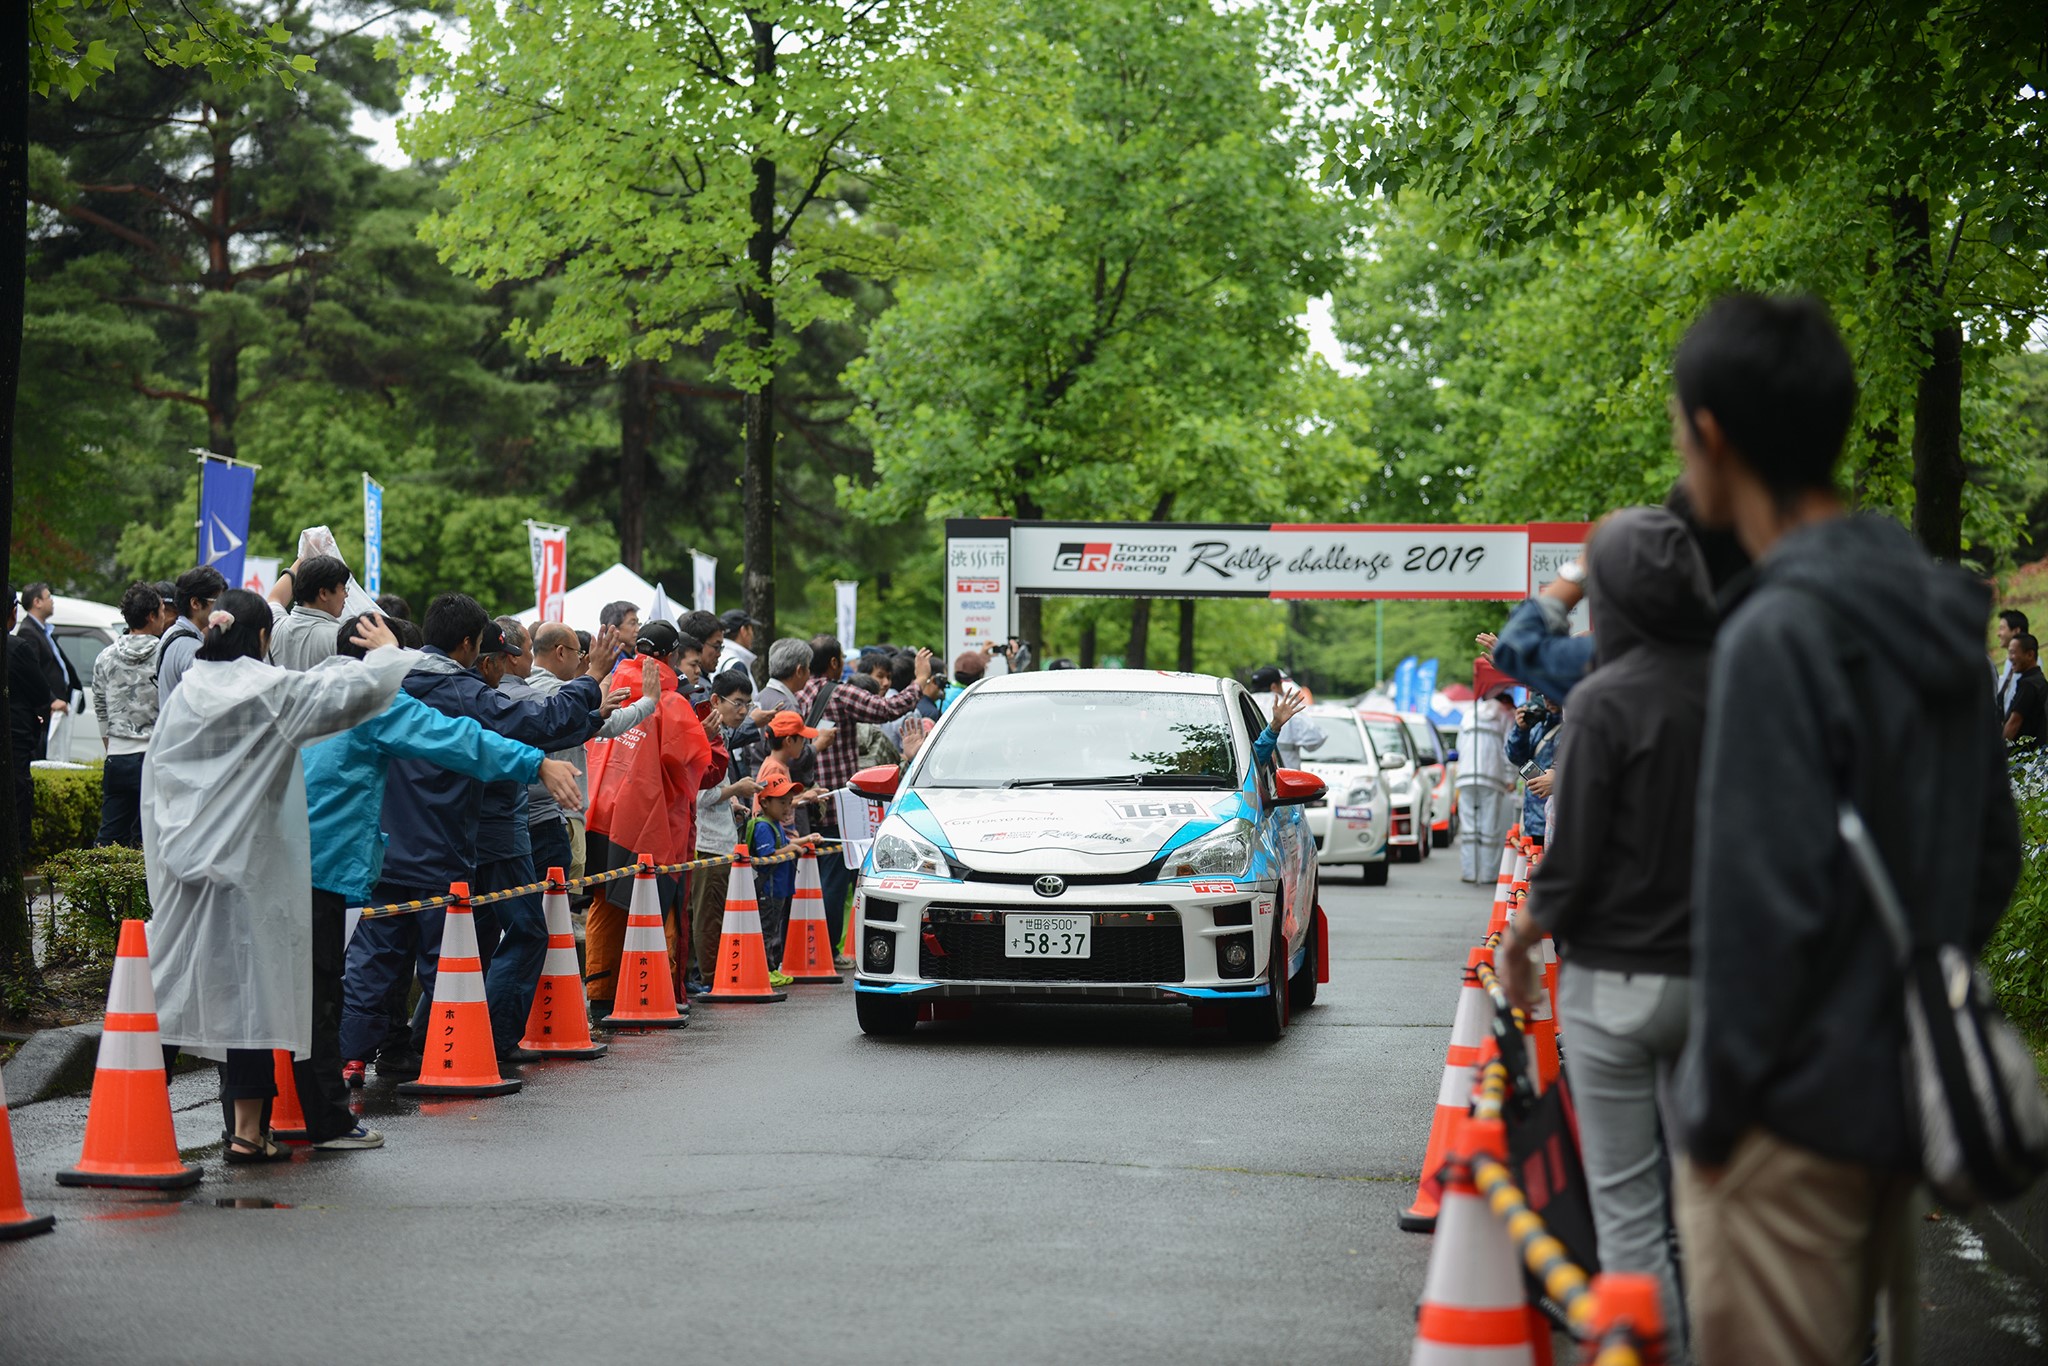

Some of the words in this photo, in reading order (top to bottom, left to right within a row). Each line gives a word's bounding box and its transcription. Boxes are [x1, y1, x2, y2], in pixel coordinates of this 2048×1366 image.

[1115, 543, 1178, 553] TOYOTA
[951, 549, 1006, 568] 渋川市
[1113, 553, 1171, 563] GAZOO
[1183, 541, 1281, 581] Rally
[1288, 545, 1392, 580] challenge
[1403, 546, 1486, 573] 2019
[1111, 563, 1167, 574] Racing
[957, 580, 1000, 593] TRD
[621, 732, 640, 742] ZOO
[629, 728, 647, 738] OTA
[1119, 803, 1197, 817] 168
[1038, 829, 1082, 840] Rally
[1084, 832, 1133, 844] challenge
[881, 879, 918, 889] TRD
[1193, 884, 1236, 893] TRD
[1024, 933, 1086, 955] 58-37
